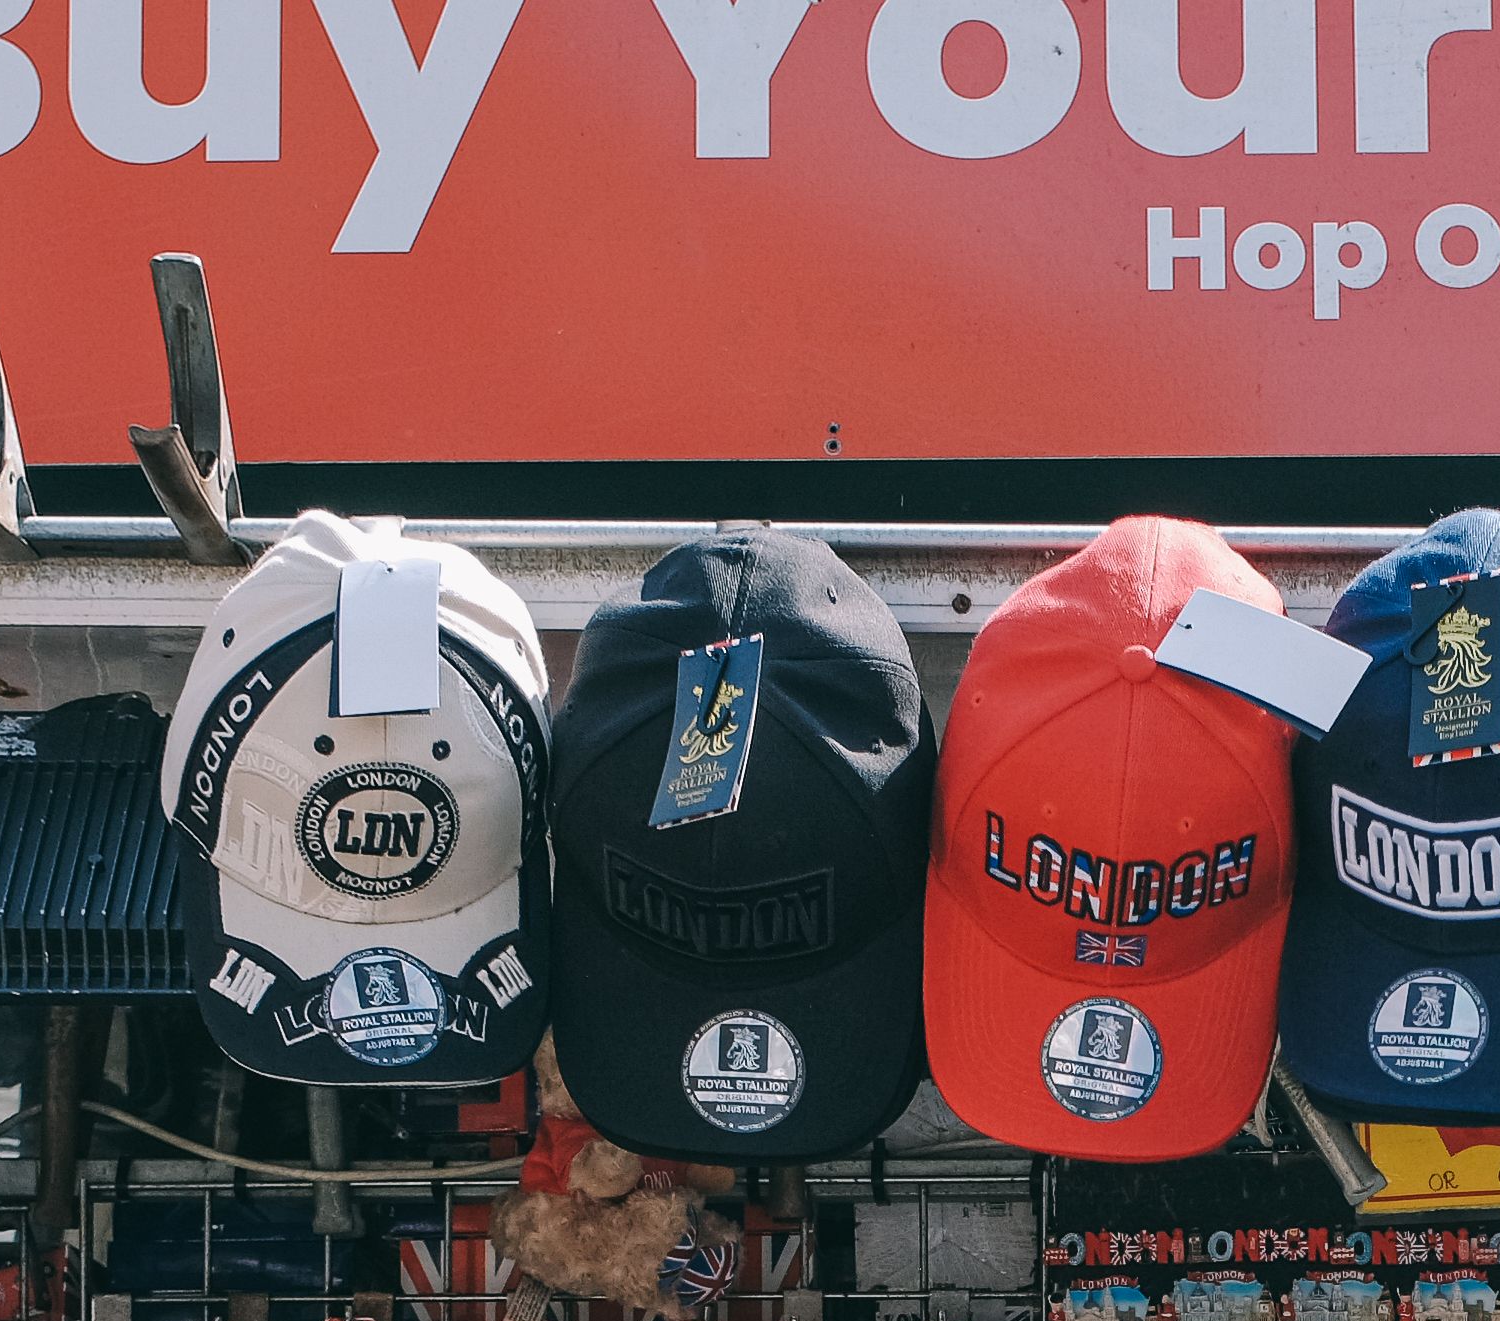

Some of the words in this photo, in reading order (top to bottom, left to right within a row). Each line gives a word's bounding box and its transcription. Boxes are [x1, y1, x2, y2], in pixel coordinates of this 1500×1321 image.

[652, 0, 1492, 159] Your
[1147, 206, 1388, 319] Hop
[1434, 692, 1480, 710] ROYAL
[1422, 702, 1492, 725] STALLION
[189, 671, 274, 825] LONDON
[347, 769, 422, 792] LONDON
[668, 770, 727, 793] STALLION
[681, 761, 721, 779] ROYAL
[334, 808, 426, 858] LDN
[985, 809, 1258, 927] LONDON
[612, 866, 826, 956] LONDON
[209, 947, 276, 1015] LDN
[476, 944, 533, 1010] LDN
[341, 1015, 381, 1031] ROYAL
[382, 1010, 434, 1025] STALLION
[366, 1036, 416, 1051] ADJUSTABLE
[1381, 1034, 1417, 1046] ROYAL
[1417, 1034, 1470, 1049] STALLION
[1054, 1060, 1090, 1076] ROYAL
[1091, 1066, 1145, 1087] STALLION
[1394, 1059, 1444, 1069] ADJUSTABLE
[697, 1079, 733, 1092] ROYAL
[736, 1079, 789, 1093] STALLION
[1069, 1088, 1120, 1106] ADJUSTABLE
[715, 1104, 766, 1116] ADJUSTABLE
[1428, 1170, 1459, 1193] OR
